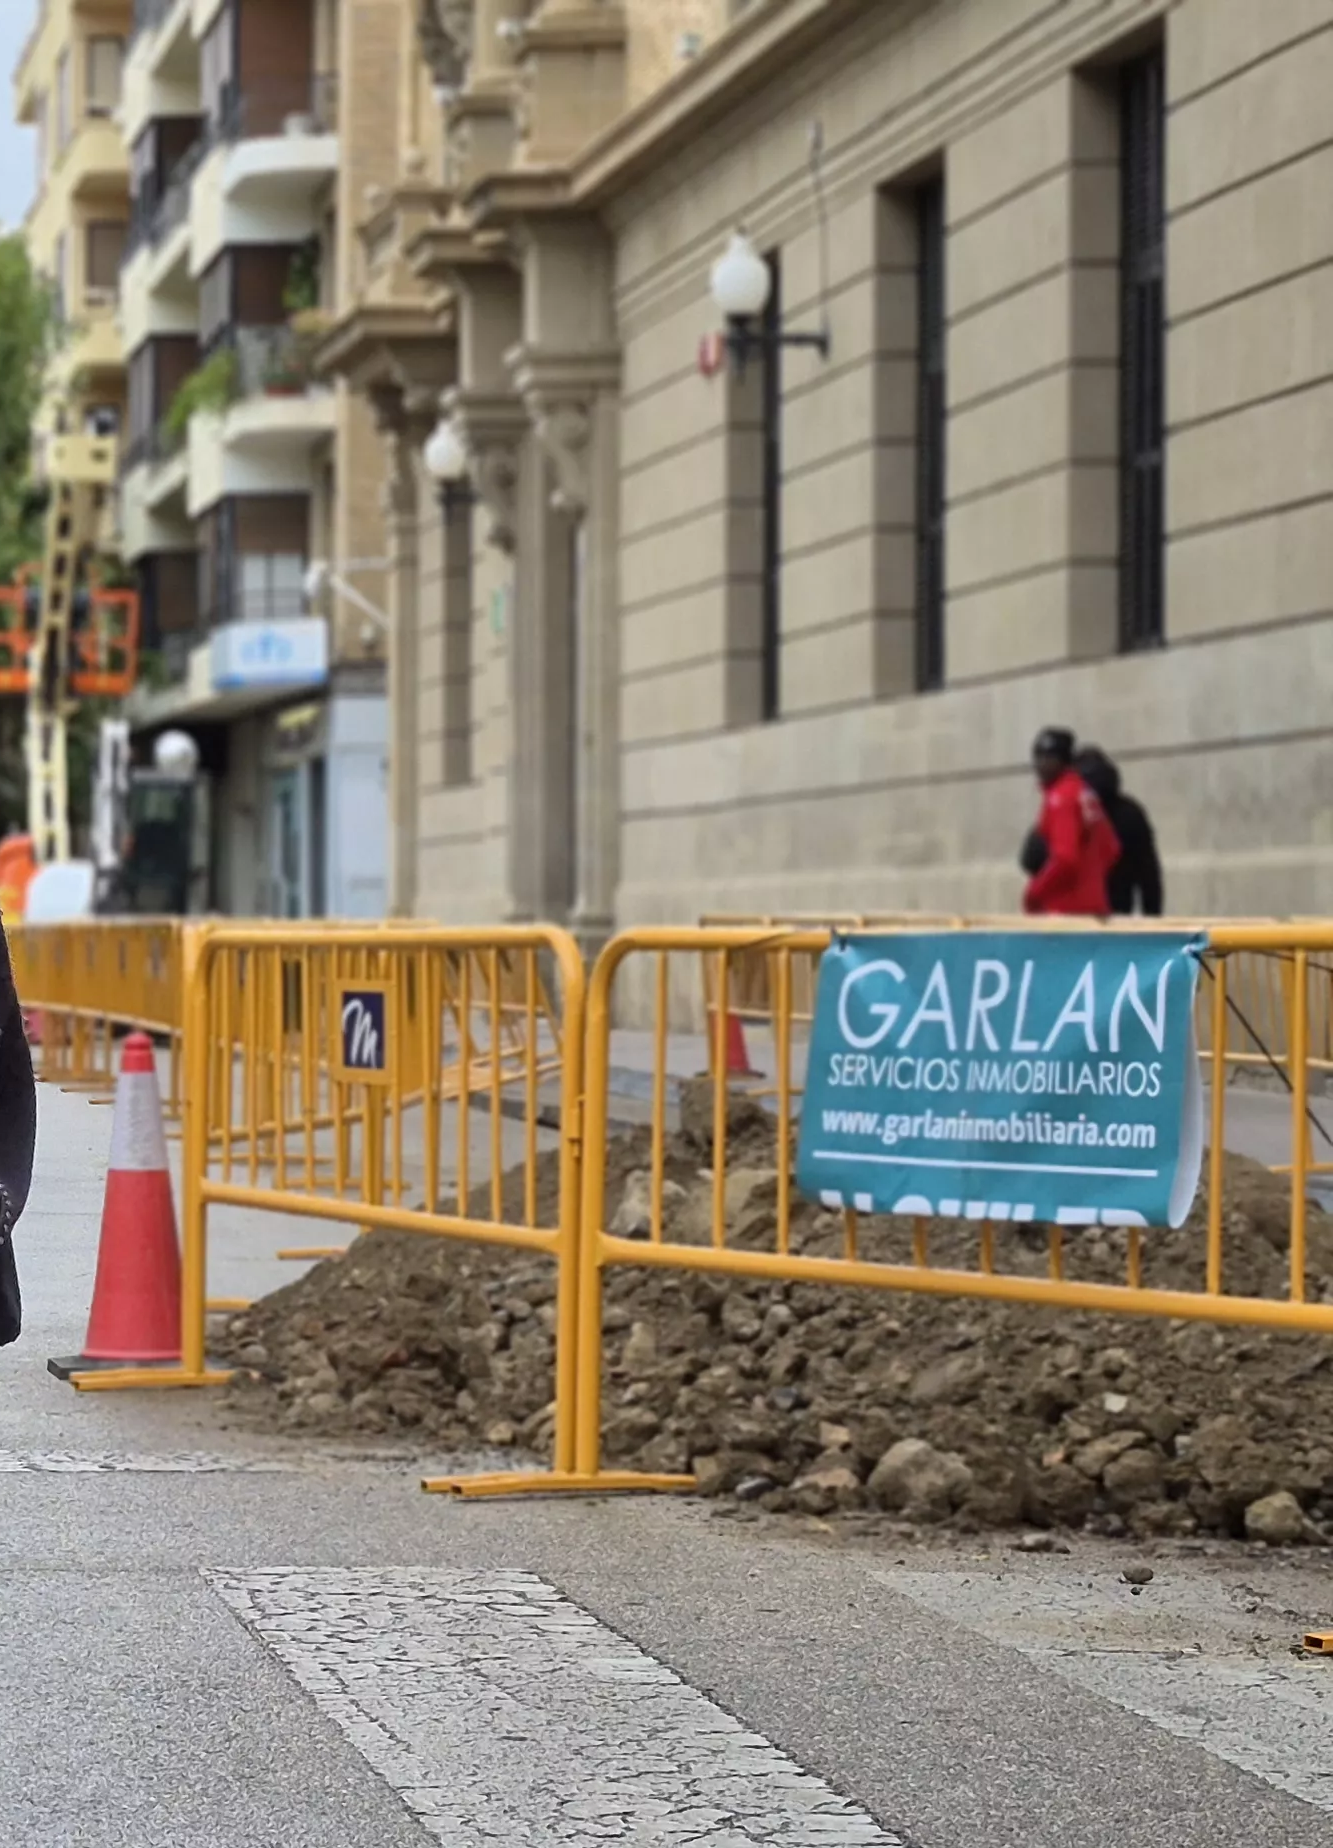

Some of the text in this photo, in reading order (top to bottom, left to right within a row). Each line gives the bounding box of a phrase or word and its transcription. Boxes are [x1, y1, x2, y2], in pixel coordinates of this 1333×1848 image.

[838, 958, 1174, 1053] GARLAN
[827, 1053, 1162, 1098] SERVICIOS INMOBILIARIOS
